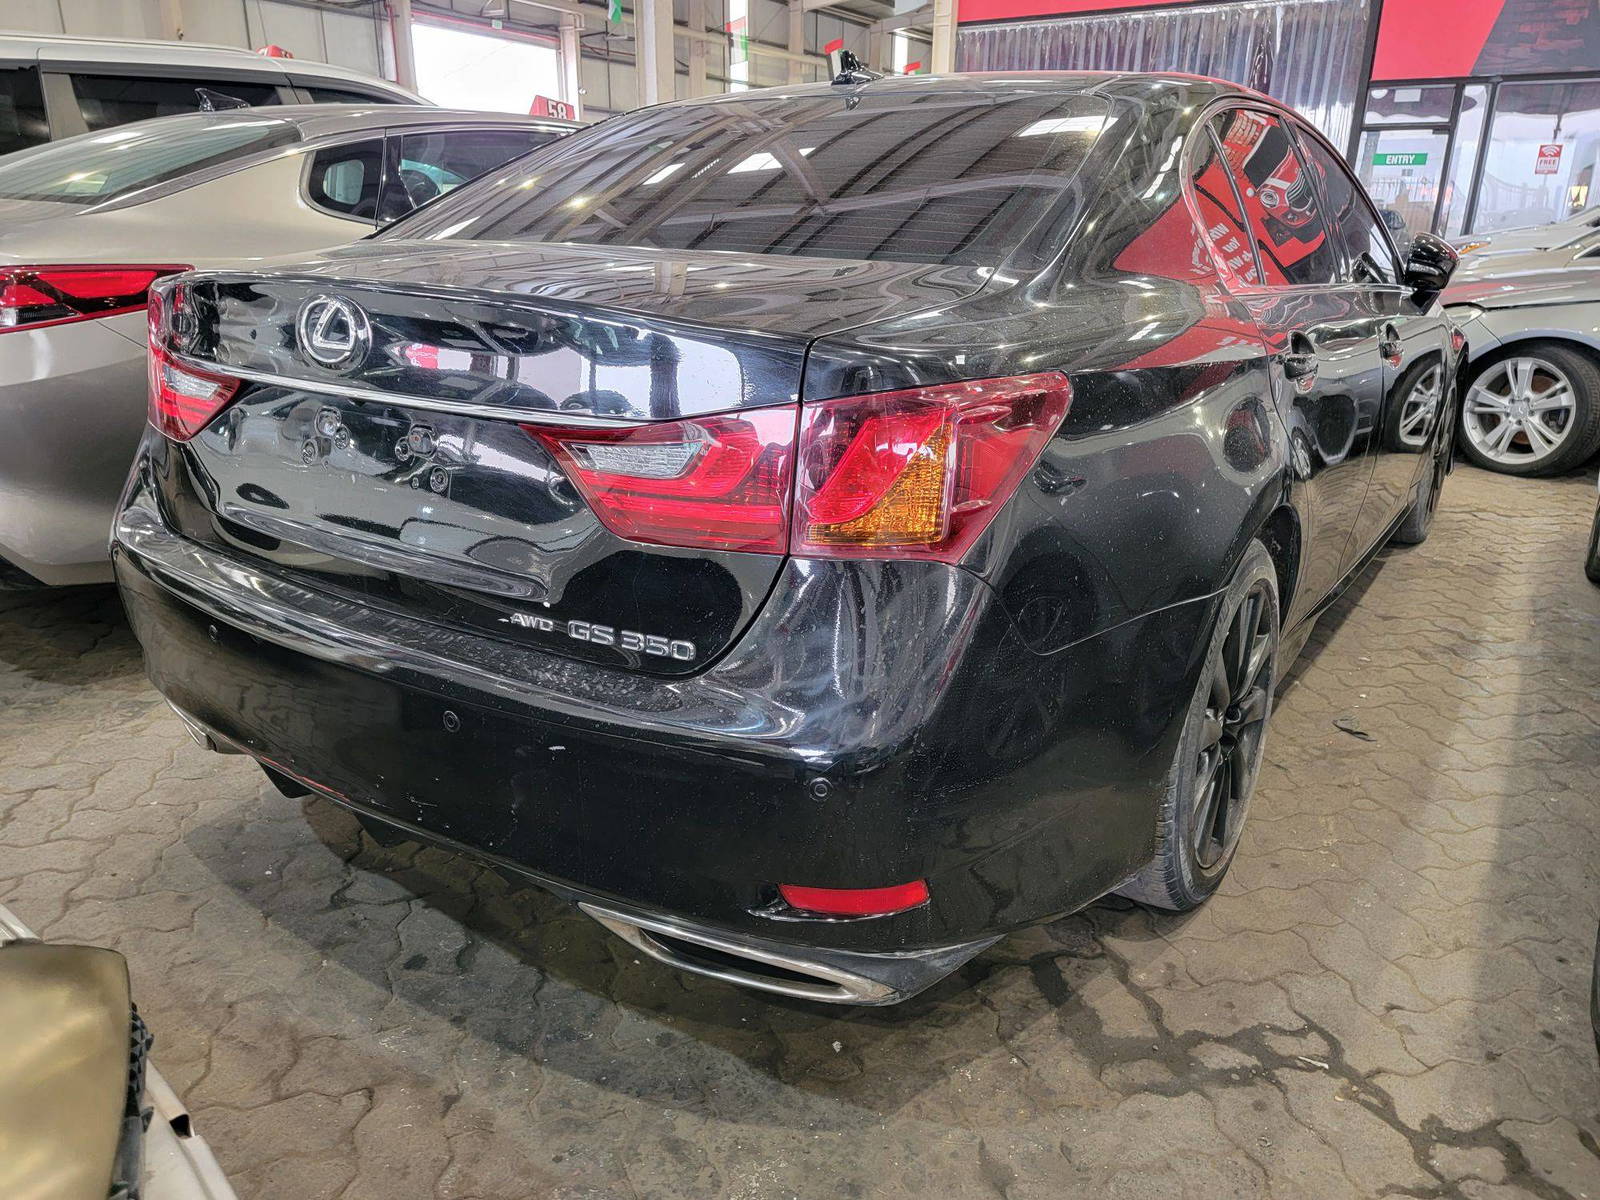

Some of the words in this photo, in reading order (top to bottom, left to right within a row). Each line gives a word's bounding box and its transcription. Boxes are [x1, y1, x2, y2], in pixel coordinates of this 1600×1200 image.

[548, 99, 567, 120] 58
[1385, 154, 1416, 165] ENTRY
[510, 612, 553, 632] AWD
[567, 619, 615, 646] GS
[621, 629, 696, 662] 350
